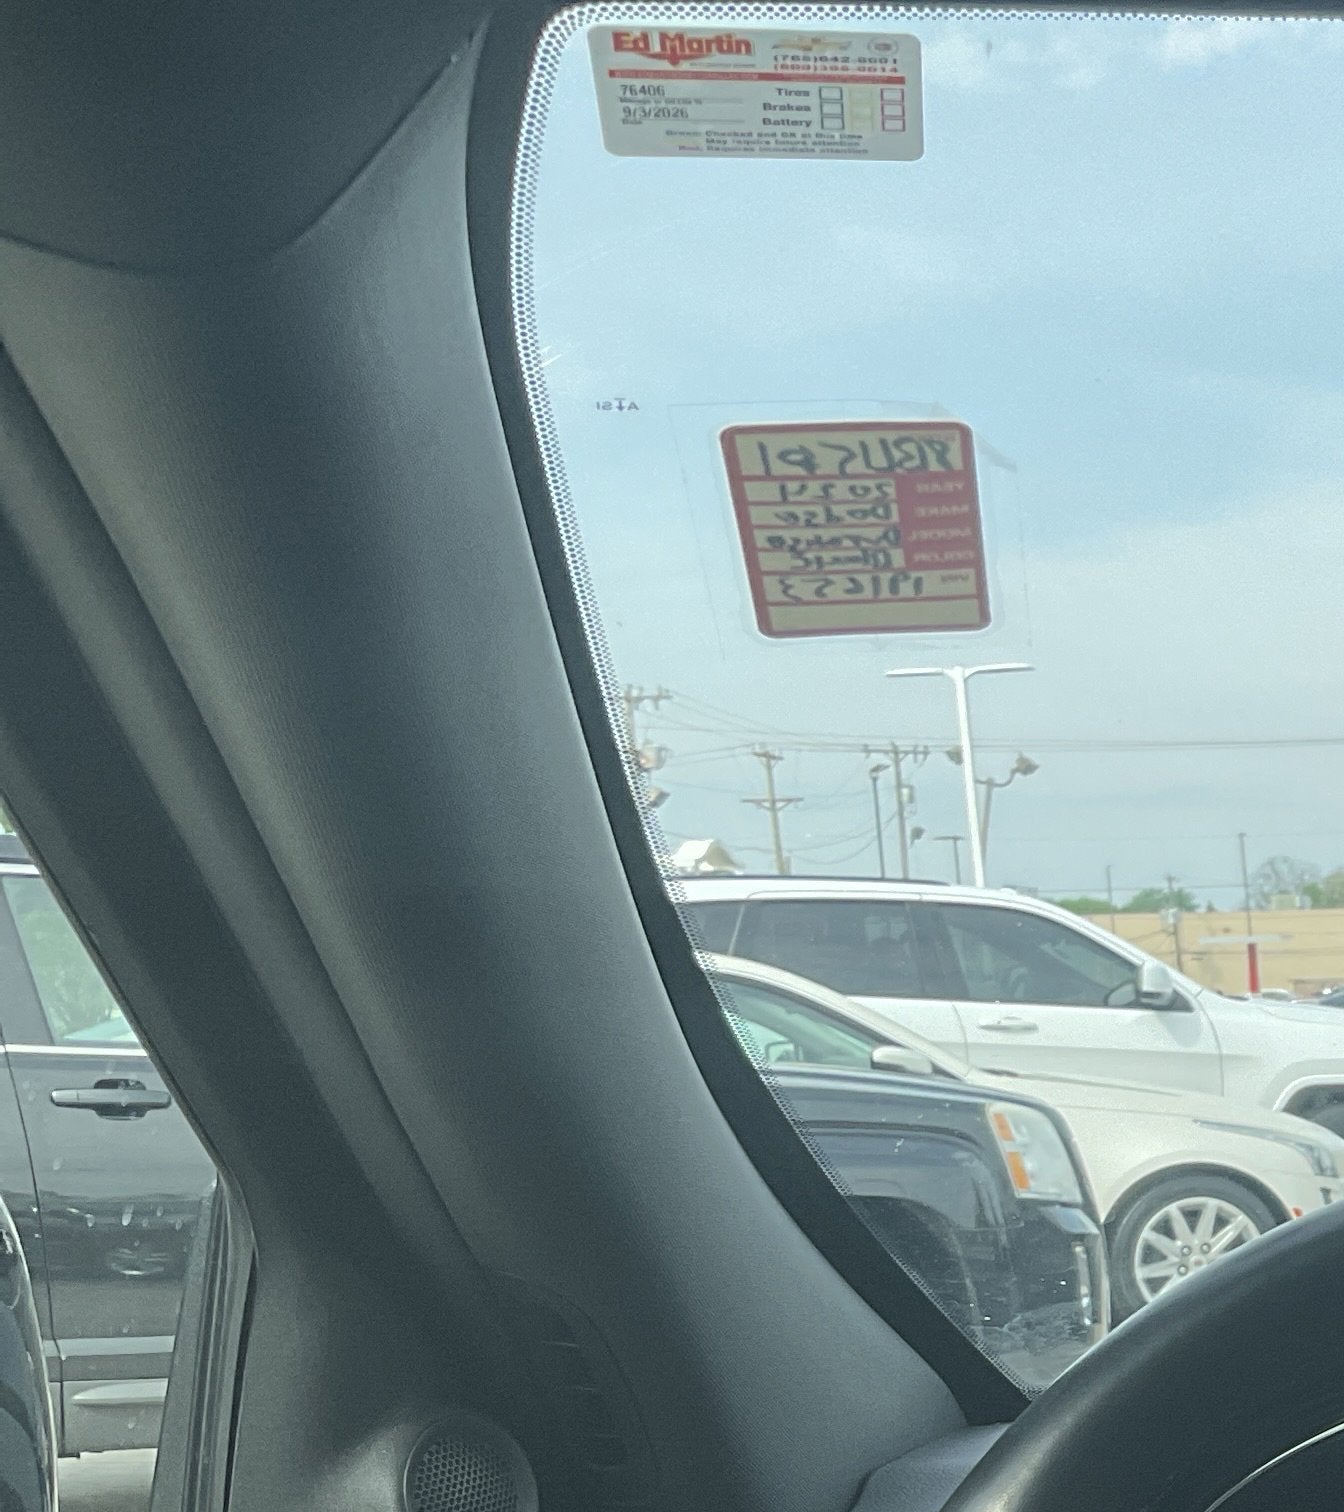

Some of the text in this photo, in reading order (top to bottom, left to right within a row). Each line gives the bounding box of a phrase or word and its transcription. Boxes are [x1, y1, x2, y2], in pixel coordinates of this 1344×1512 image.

[612, 31, 753, 56] Ed Martin
[775, 88, 810, 97] Tires
[622, 106, 689, 119] 9/3/2026
[762, 102, 811, 112] Brakes
[762, 117, 812, 128] Battery
